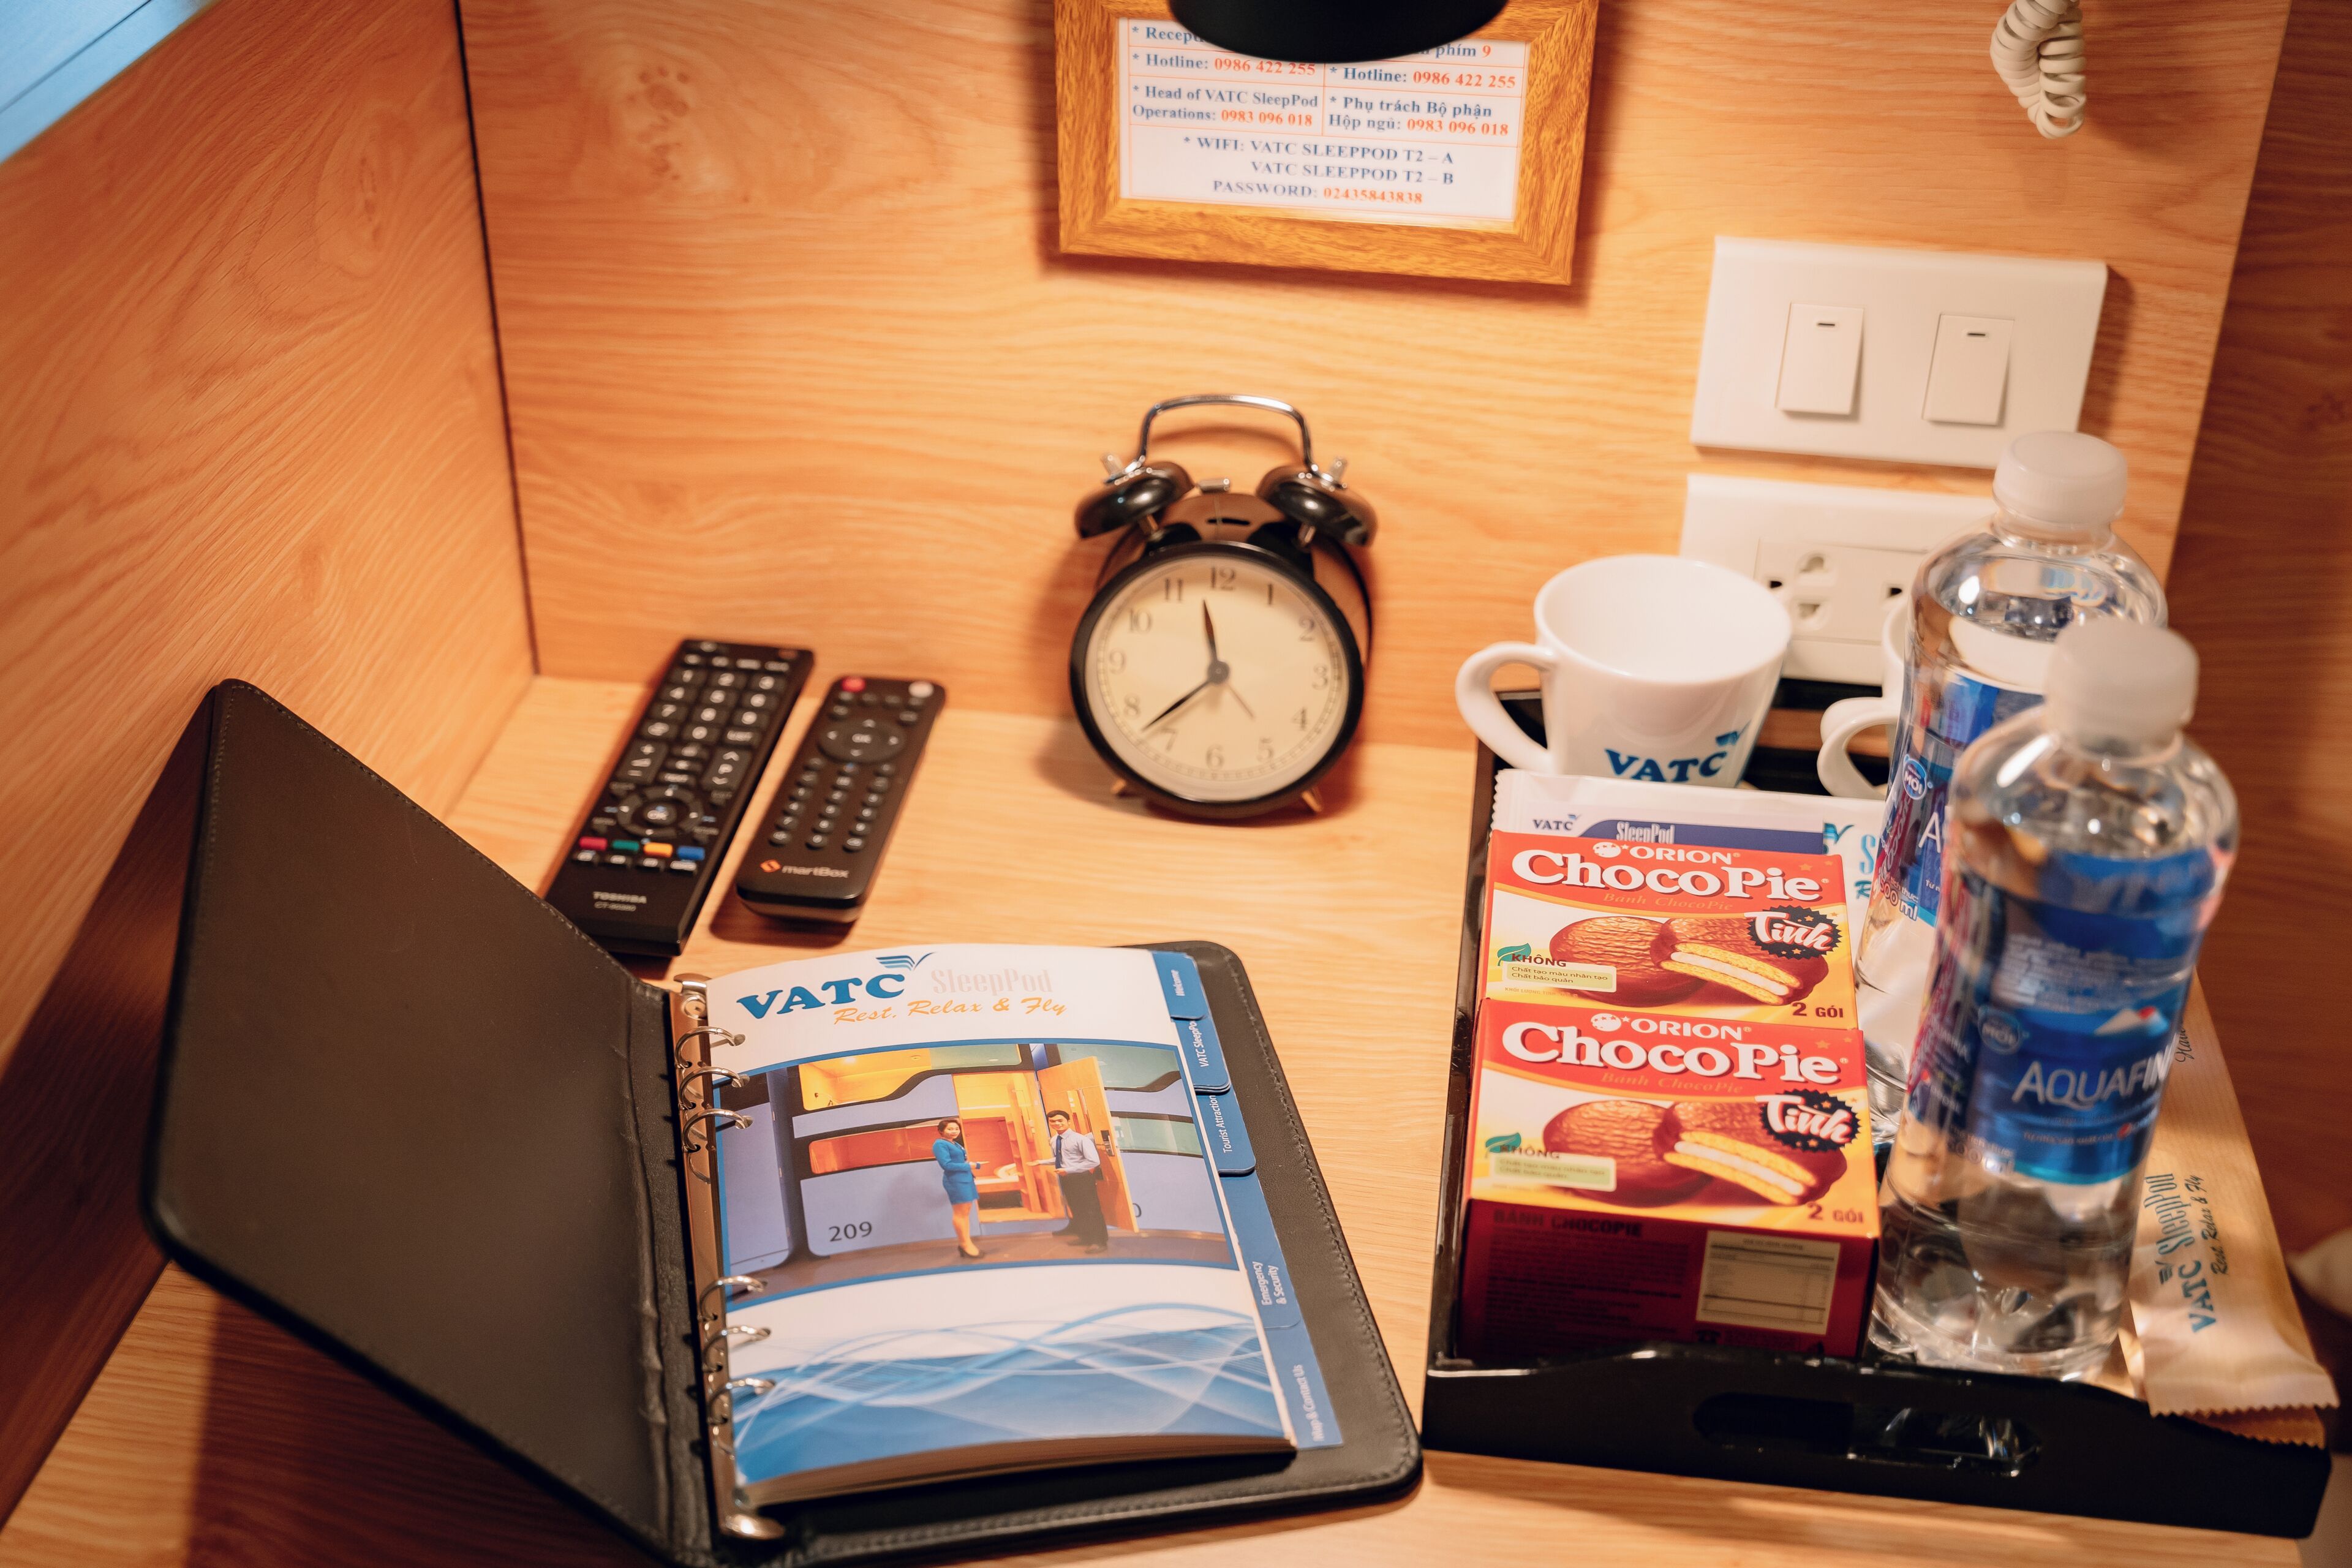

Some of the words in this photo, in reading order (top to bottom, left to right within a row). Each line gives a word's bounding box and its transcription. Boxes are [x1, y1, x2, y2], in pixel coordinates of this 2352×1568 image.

[1435, 43, 1476, 59] phím
[1482, 45, 1491, 59] 9
[1145, 53, 1208, 70] Hotline:
[1214, 57, 1251, 72] 0986
[1256, 61, 1283, 74] 422
[1288, 63, 1316, 76] 255
[1343, 67, 1407, 83] Hotline:
[1412, 70, 1450, 85] 0986
[1455, 74, 1482, 87] 422
[1488, 75, 1516, 89] 255
[1145, 86, 1182, 99] Head
[1187, 88, 1202, 100] of
[1205, 90, 1248, 104] VATC
[1252, 93, 1319, 108] SleepPod
[1343, 96, 1374, 113] Phụ
[1379, 99, 1420, 113] trách
[1426, 101, 1447, 117] Bộ
[1452, 103, 1492, 119] phận
[1133, 104, 1216, 121] Operations:
[1221, 110, 1254, 123] 0983
[1259, 113, 1283, 126] 096
[1288, 114, 1313, 127] 018
[1329, 114, 1361, 130] Hộp
[1406, 119, 1444, 132] 0983
[1449, 121, 1476, 135] 096
[1481, 123, 1509, 136] 018
[1197, 137, 1244, 152] WIFI:
[1251, 140, 1297, 156] VATC
[1302, 143, 1398, 161] SLEEPPOD
[1403, 149, 1423, 162] T2
[1441, 153, 1455, 164] A
[1251, 161, 1297, 176] VATC
[1302, 165, 1398, 182] SLEEPPOD
[1403, 171, 1423, 183] T2
[1442, 173, 1454, 185] B
[1213, 180, 1317, 198] PASSWORD:
[1323, 187, 1423, 205] 02435843838
[1164, 577, 1184, 602] 11
[1209, 567, 1236, 590] 12
[1128, 609, 1153, 633] 10
[1298, 616, 1316, 642] 2
[1108, 649, 1126, 674] 9
[1311, 664, 1329, 690] 3
[1123, 694, 1141, 717] 8
[1292, 706, 1308, 731] 4
[1205, 744, 1224, 770] 6
[1256, 737, 1274, 763] 5
[1604, 748, 1727, 782] VATC
[1532, 819, 1574, 831] VATC
[1616, 821, 1676, 845] SleepPod
[1629, 845, 1732, 865] ORION
[1512, 849, 1820, 900] ChocoPie
[1511, 954, 1567, 967] KHÔNG
[736, 974, 905, 1019] VATC
[930, 968, 1054, 997] SleepPod
[907, 999, 983, 1017] Relax
[992, 997, 1011, 1012] &
[1020, 997, 1068, 1016] Fly
[1792, 1002, 1807, 1017] 2
[1815, 1005, 1844, 1018] GÓI
[1189, 1020, 1204, 1048] SleepPo
[1630, 1019, 1743, 1040] ORION
[1195, 1049, 1210, 1068] VATC
[1502, 1021, 1839, 1084] ChocoPie
[2011, 1033, 2179, 1111] AQUAFIN
[1218, 1129, 1233, 1153] Tourist
[1807, 1201, 1823, 1220] 2
[1833, 1208, 1864, 1223] GÓI
[2143, 1172, 2195, 1255] SleepPod
[828, 1221, 872, 1242] 209
[1252, 1261, 1272, 1306] Emergency
[1268, 1265, 1285, 1297] Security
[1276, 1297, 1287, 1305] &
[2178, 1259, 2217, 1333] VATC
[1297, 1376, 1316, 1409] Contact
